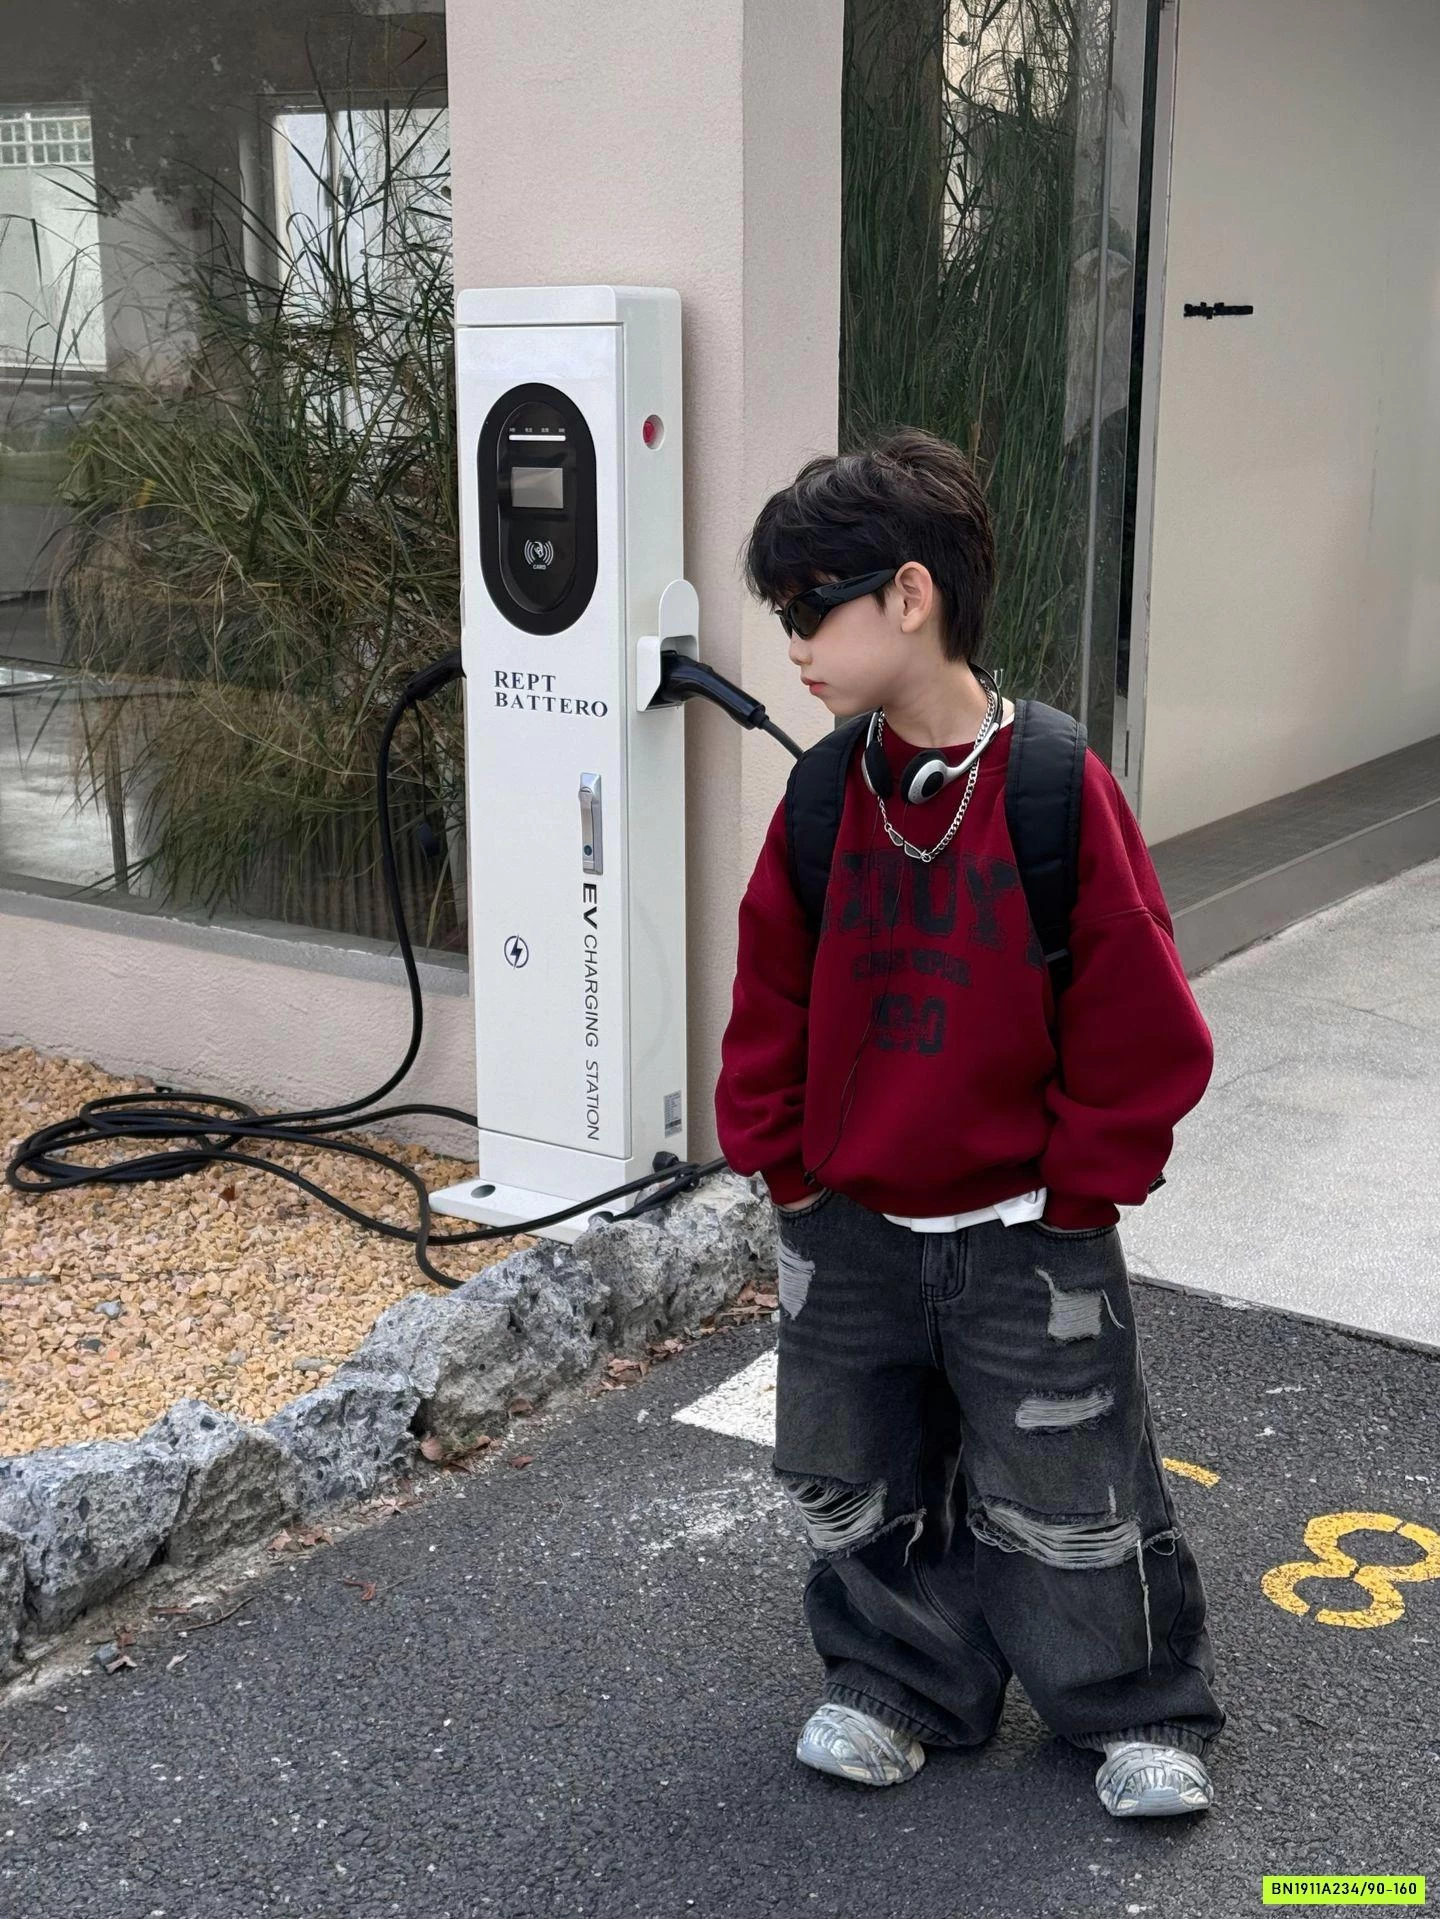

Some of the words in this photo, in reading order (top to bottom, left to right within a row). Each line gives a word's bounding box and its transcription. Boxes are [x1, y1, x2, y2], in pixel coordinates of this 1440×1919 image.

[494, 670, 556, 693] REPT
[495, 691, 608, 718] BATTERO
[583, 882, 598, 929] EV
[584, 934, 599, 1047] CHARGING
[585, 1059, 600, 1141] STATION
